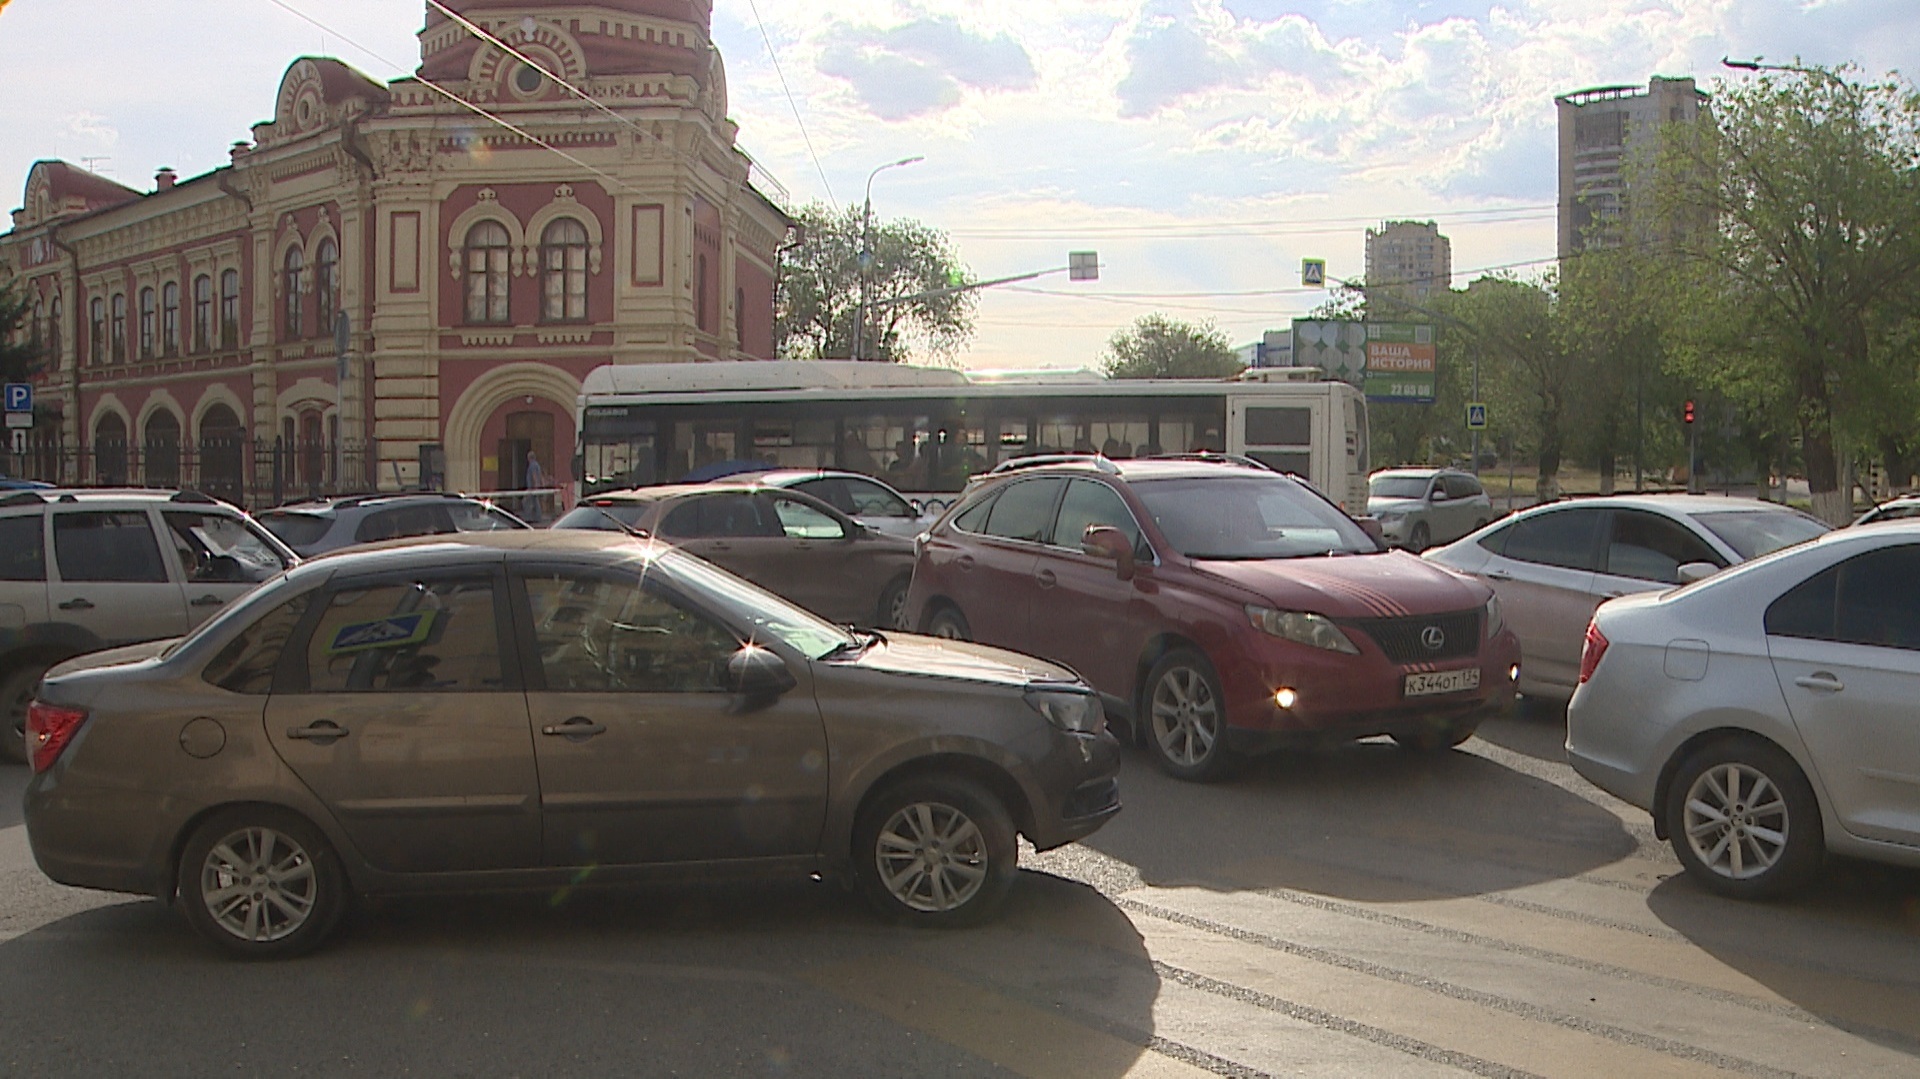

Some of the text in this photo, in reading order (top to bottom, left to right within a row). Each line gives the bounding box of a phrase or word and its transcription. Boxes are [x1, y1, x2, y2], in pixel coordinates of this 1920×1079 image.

[1371, 345, 1410, 357] ВАША
[1371, 357, 1430, 369] ИСТОРИЯ
[12, 387, 27, 407] P
